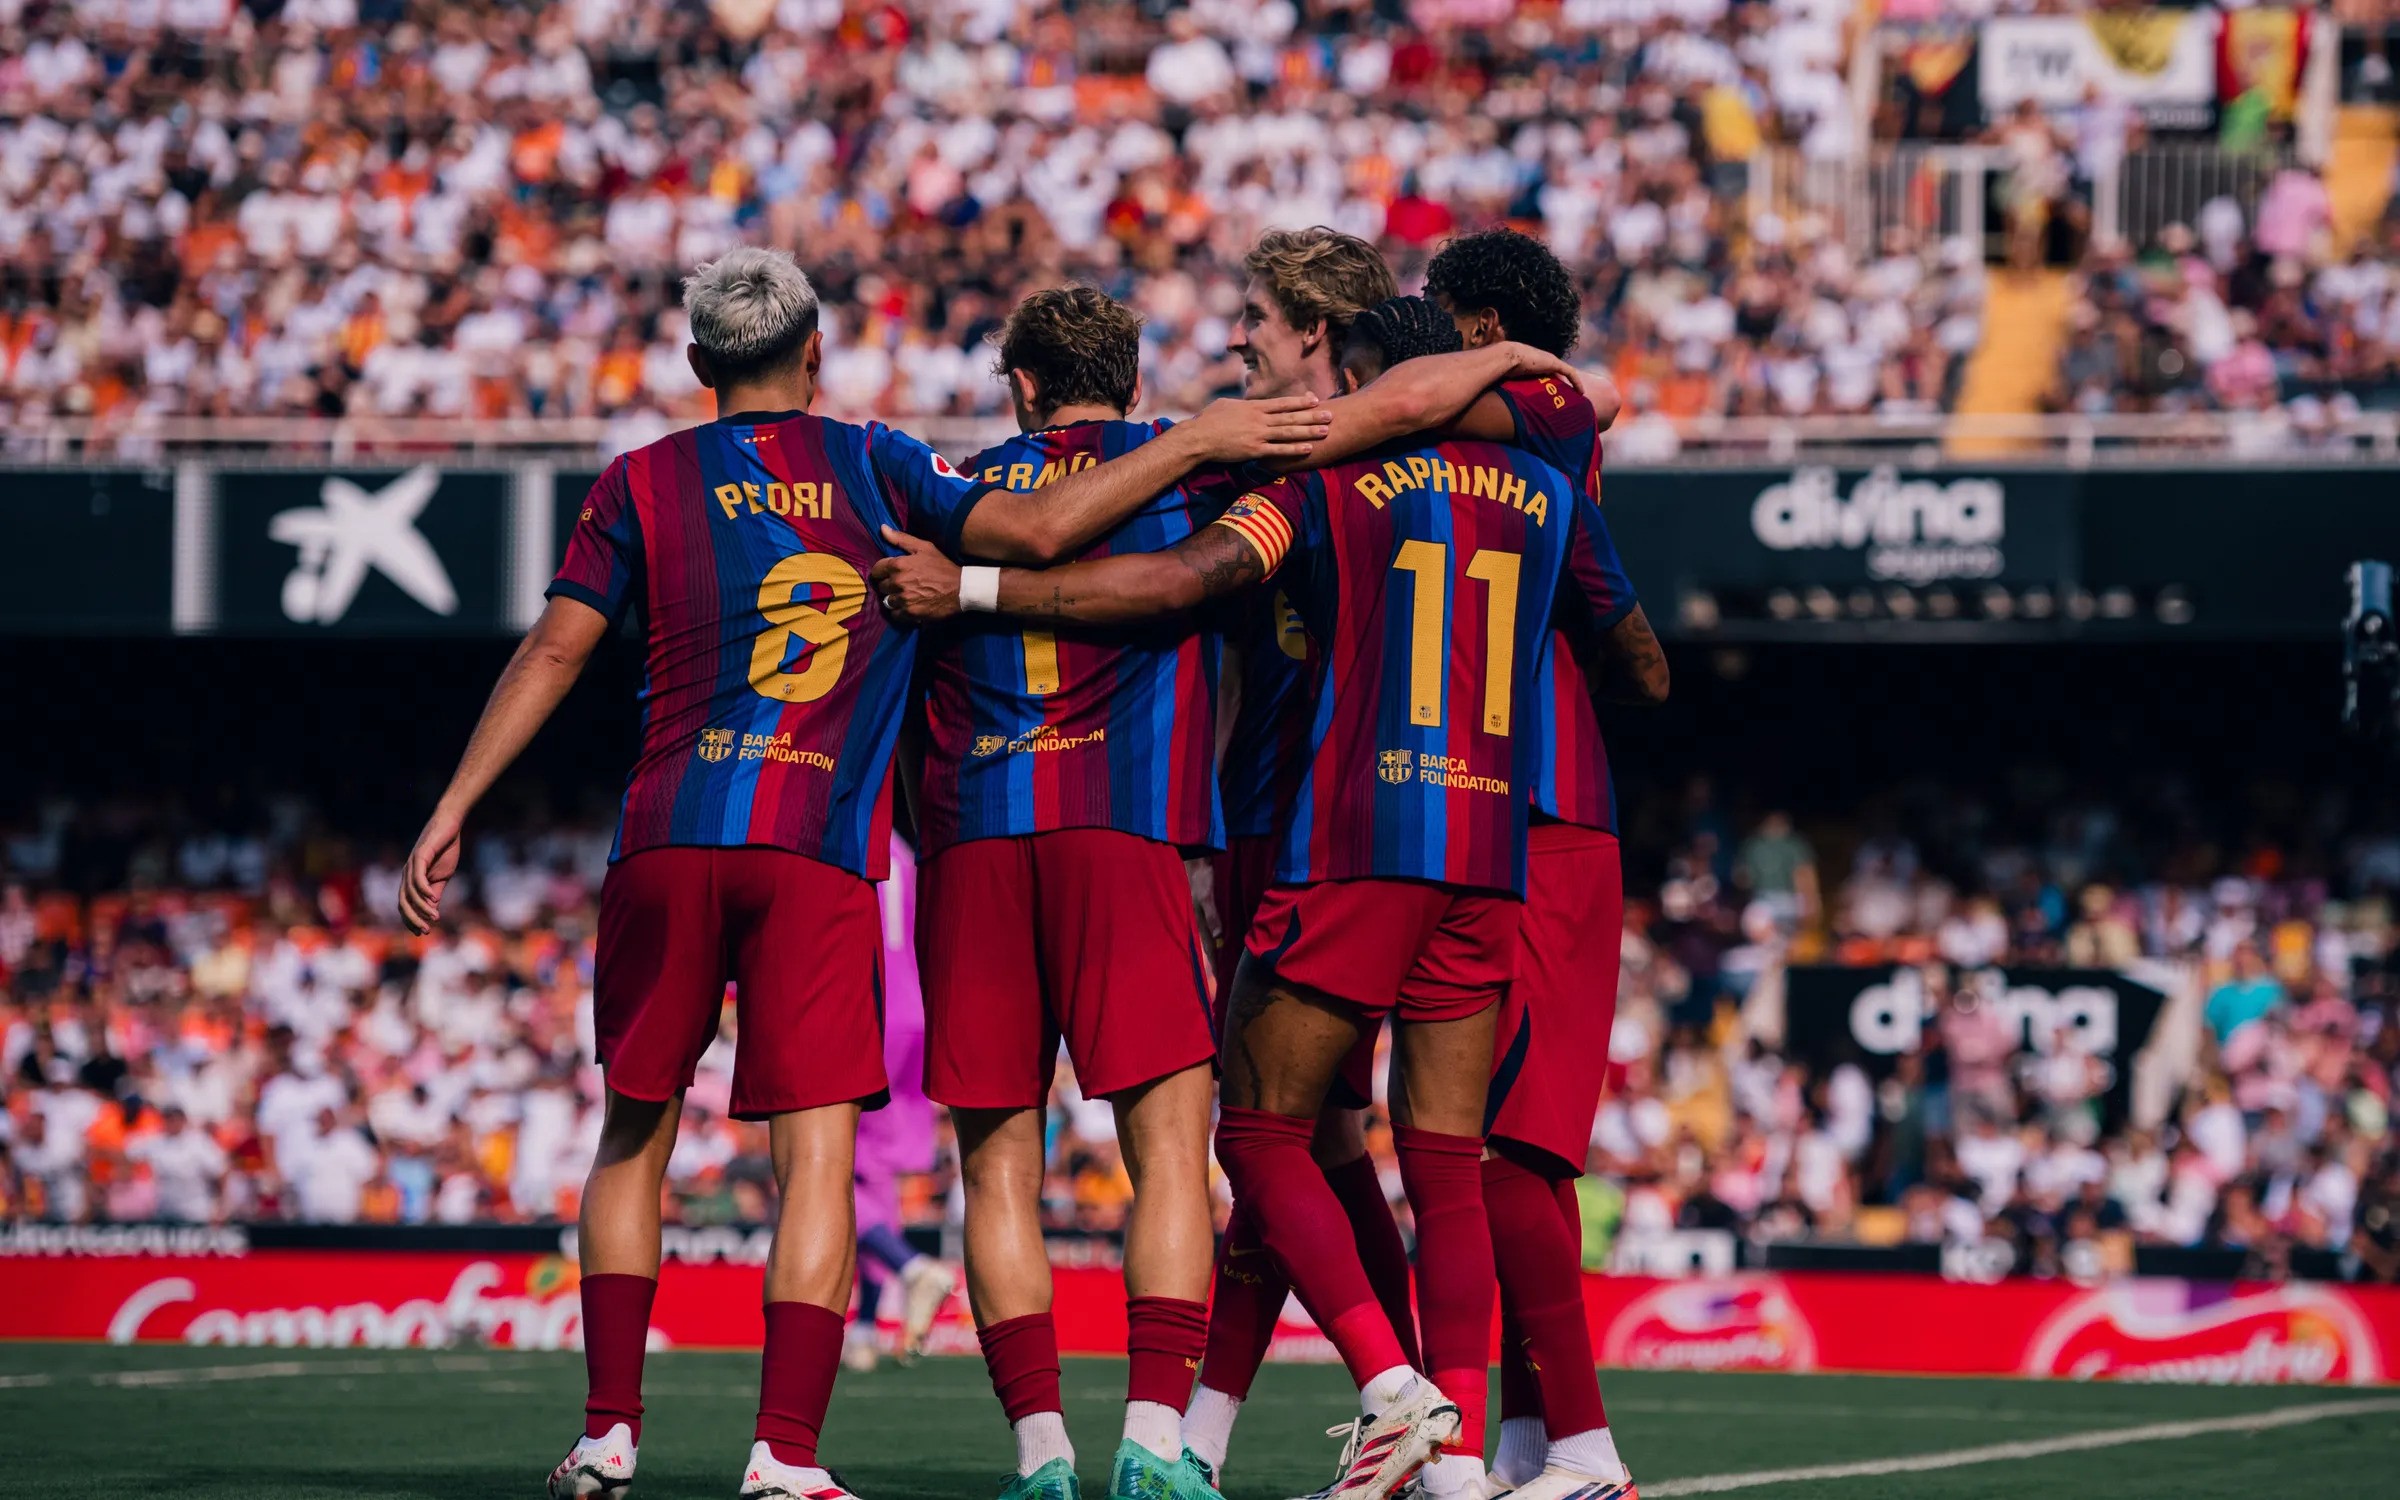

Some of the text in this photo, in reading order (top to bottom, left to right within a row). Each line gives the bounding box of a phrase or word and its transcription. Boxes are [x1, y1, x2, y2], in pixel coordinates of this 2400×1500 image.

[973, 451, 1097, 490] ERMÍ
[714, 481, 833, 520] PEDRI
[1354, 456, 1549, 527] RAPHINHA
[747, 552, 868, 703] 8
[1392, 539, 1522, 737] 11
[738, 746, 835, 771] FOUNDATION
[1007, 728, 1105, 754] FOUNDATN
[1419, 753, 1468, 774] BARÇA
[1419, 769, 1509, 795] FOUNDATION
